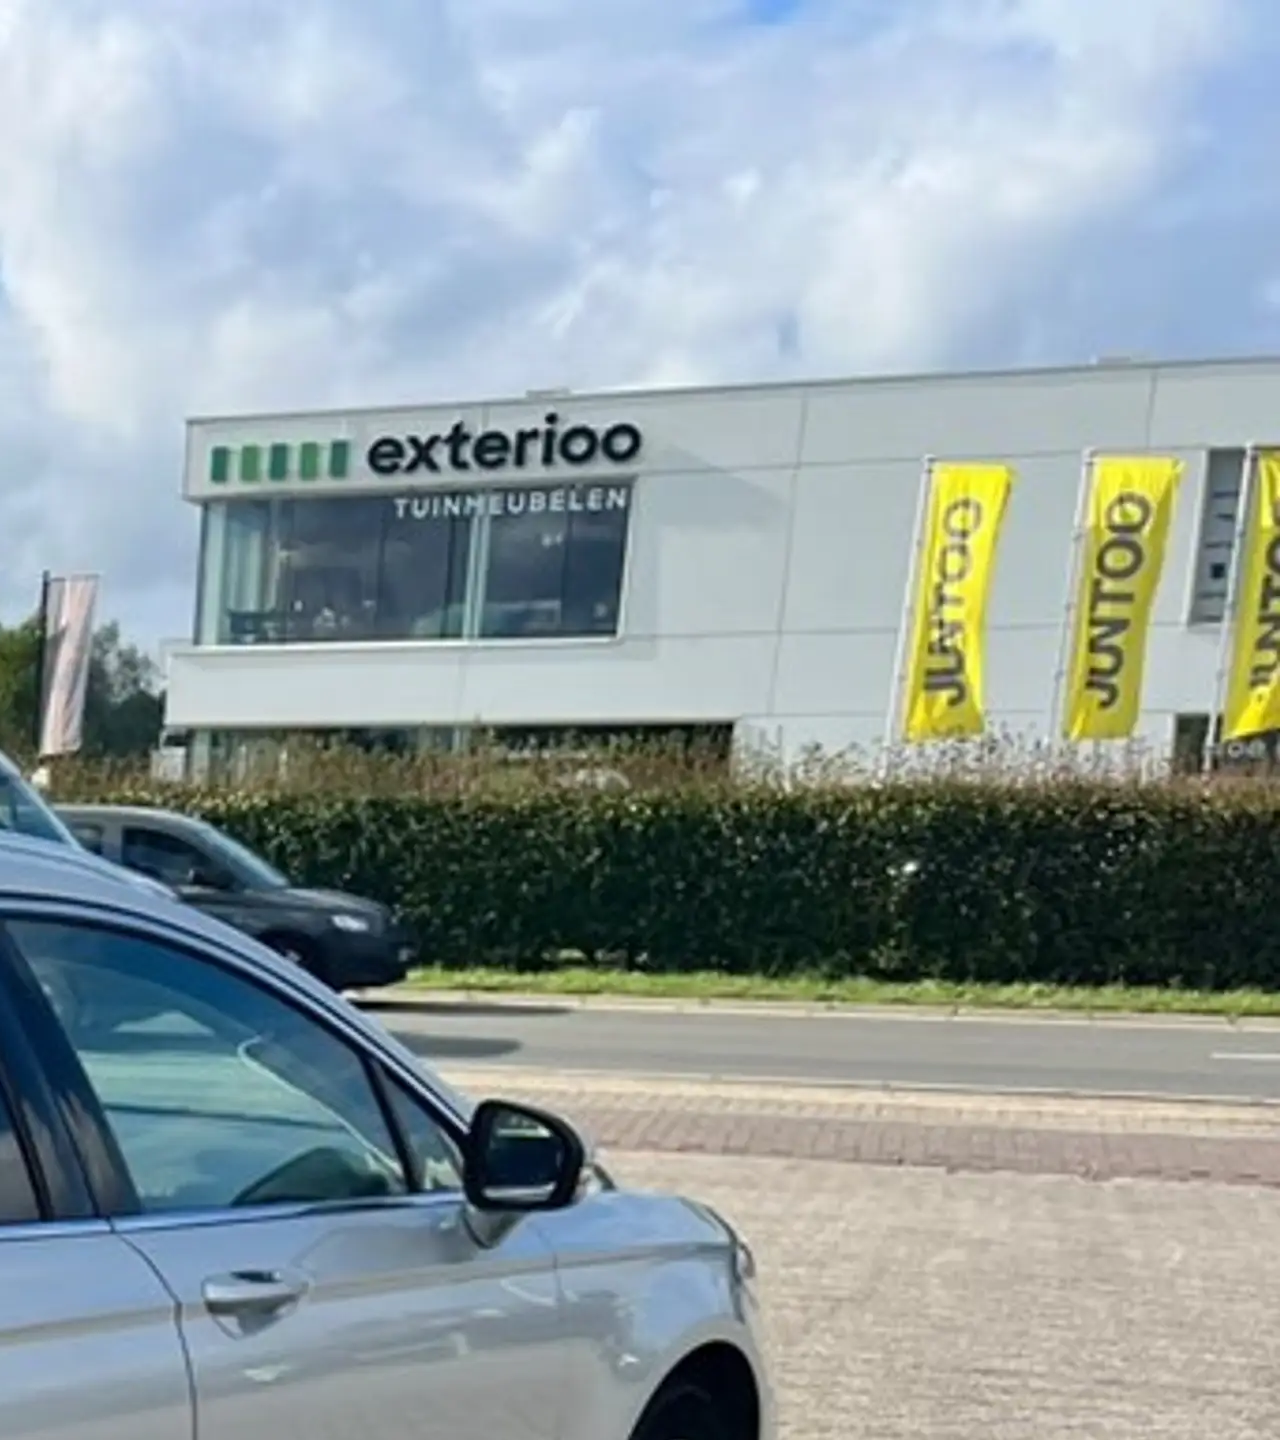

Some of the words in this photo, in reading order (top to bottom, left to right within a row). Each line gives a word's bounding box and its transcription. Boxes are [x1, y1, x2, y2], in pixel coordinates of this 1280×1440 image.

[367, 412, 643, 477] exterioo
[393, 486, 629, 520] TUINMEUBELEN
[923, 496, 983, 706] JUNTOO
[1084, 491, 1153, 710] JUNTOO
